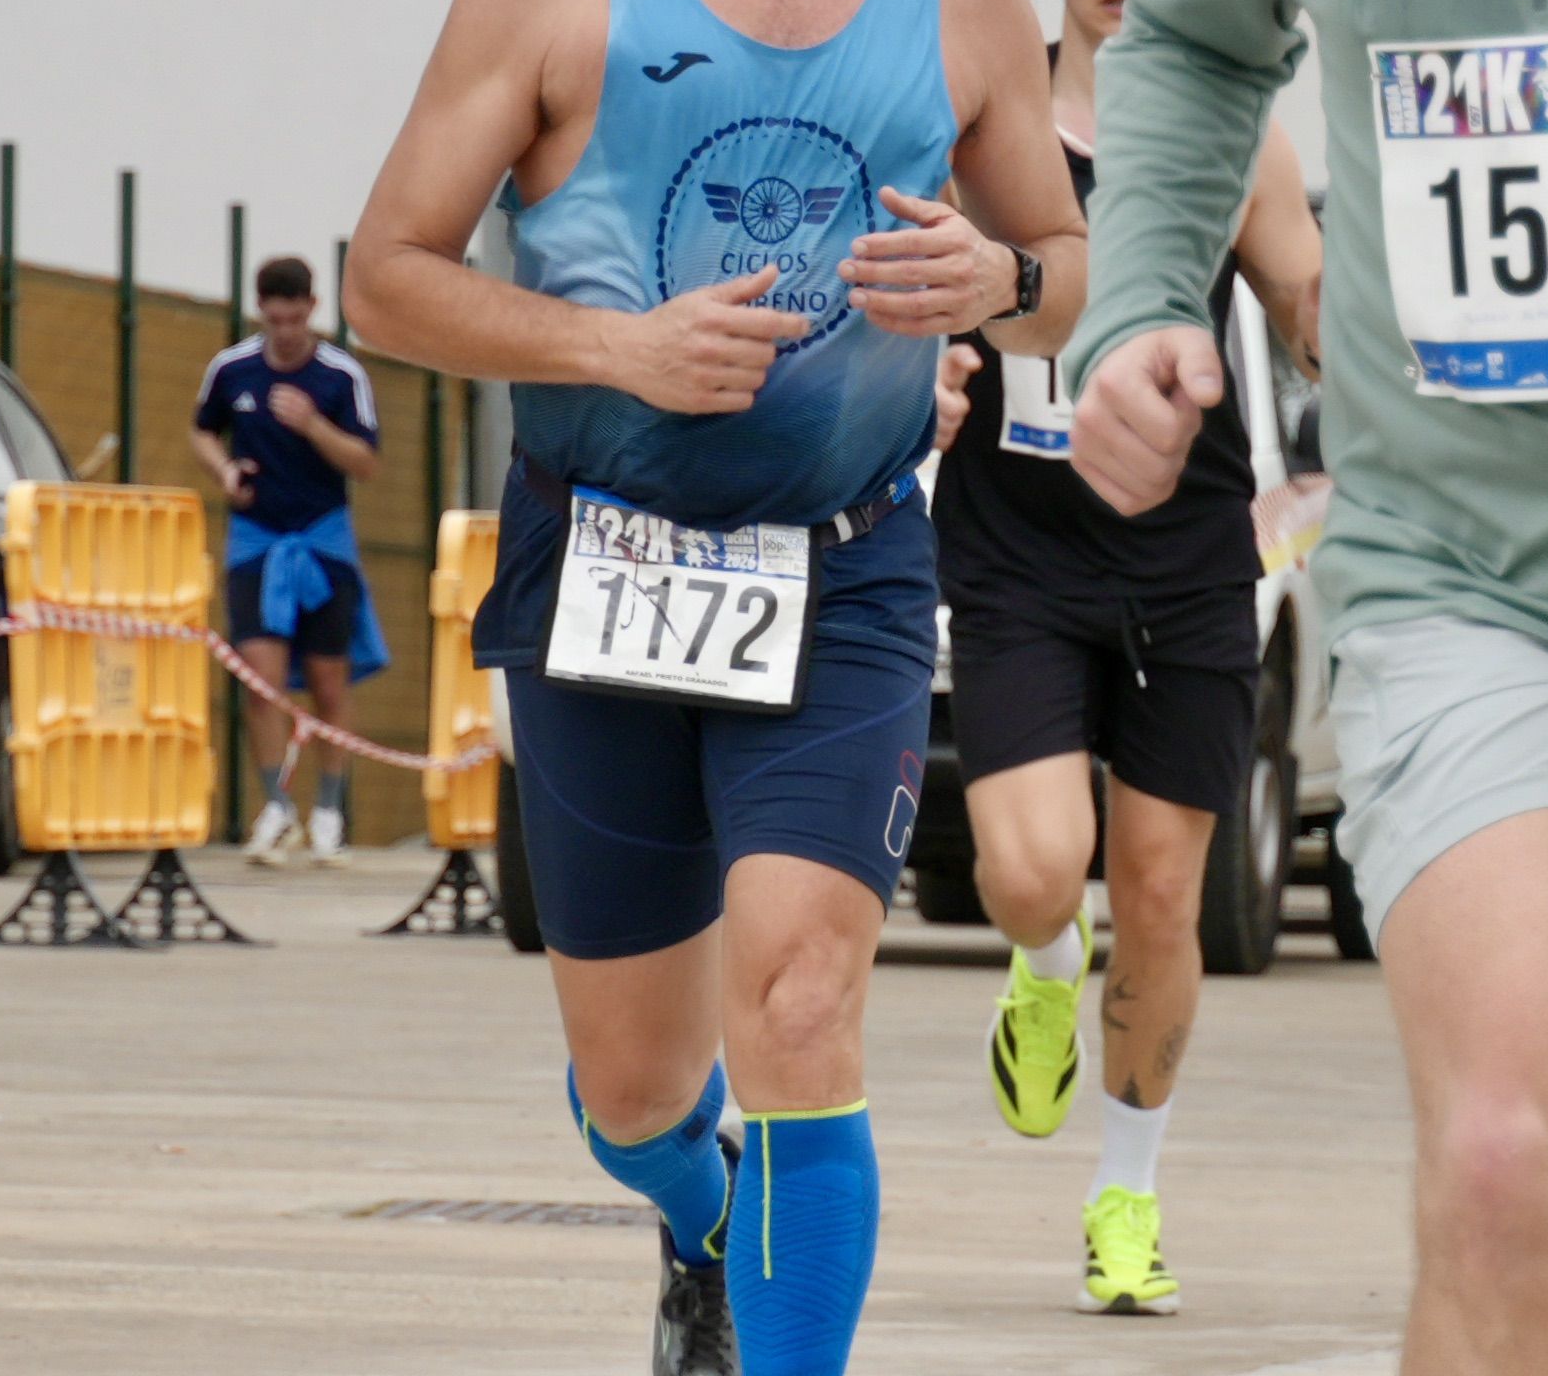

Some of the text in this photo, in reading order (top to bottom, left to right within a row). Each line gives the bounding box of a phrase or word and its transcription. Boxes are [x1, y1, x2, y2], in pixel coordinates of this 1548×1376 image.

[1417, 52, 1532, 135] 21K
[598, 506, 674, 564] 21K
[723, 553, 757, 572] 2026
[597, 571, 779, 673] 1172
[655, 672, 683, 682] PRIETO
